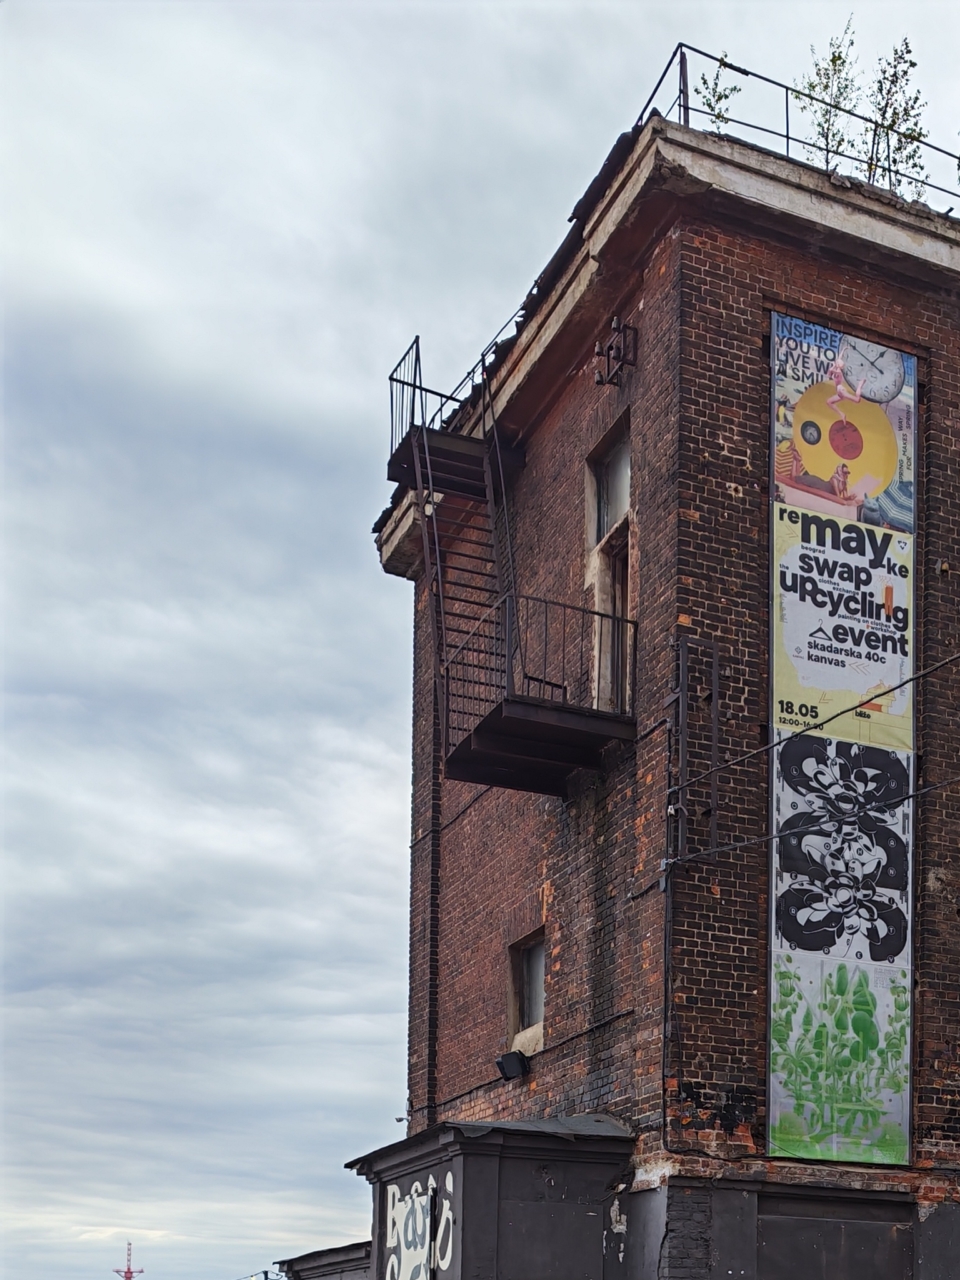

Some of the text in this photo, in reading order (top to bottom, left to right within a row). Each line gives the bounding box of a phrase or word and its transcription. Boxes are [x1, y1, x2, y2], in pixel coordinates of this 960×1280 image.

[776, 318, 838, 349] INSPIRE
[775, 333, 836, 362] YOU TO
[776, 348, 811, 370] LIVE
[799, 553, 873, 591] swap
[807, 639, 887, 665] skadarska 40c
[832, 624, 909, 658] event
[807, 650, 847, 668] kanvas
[778, 699, 819, 719] 18.05
